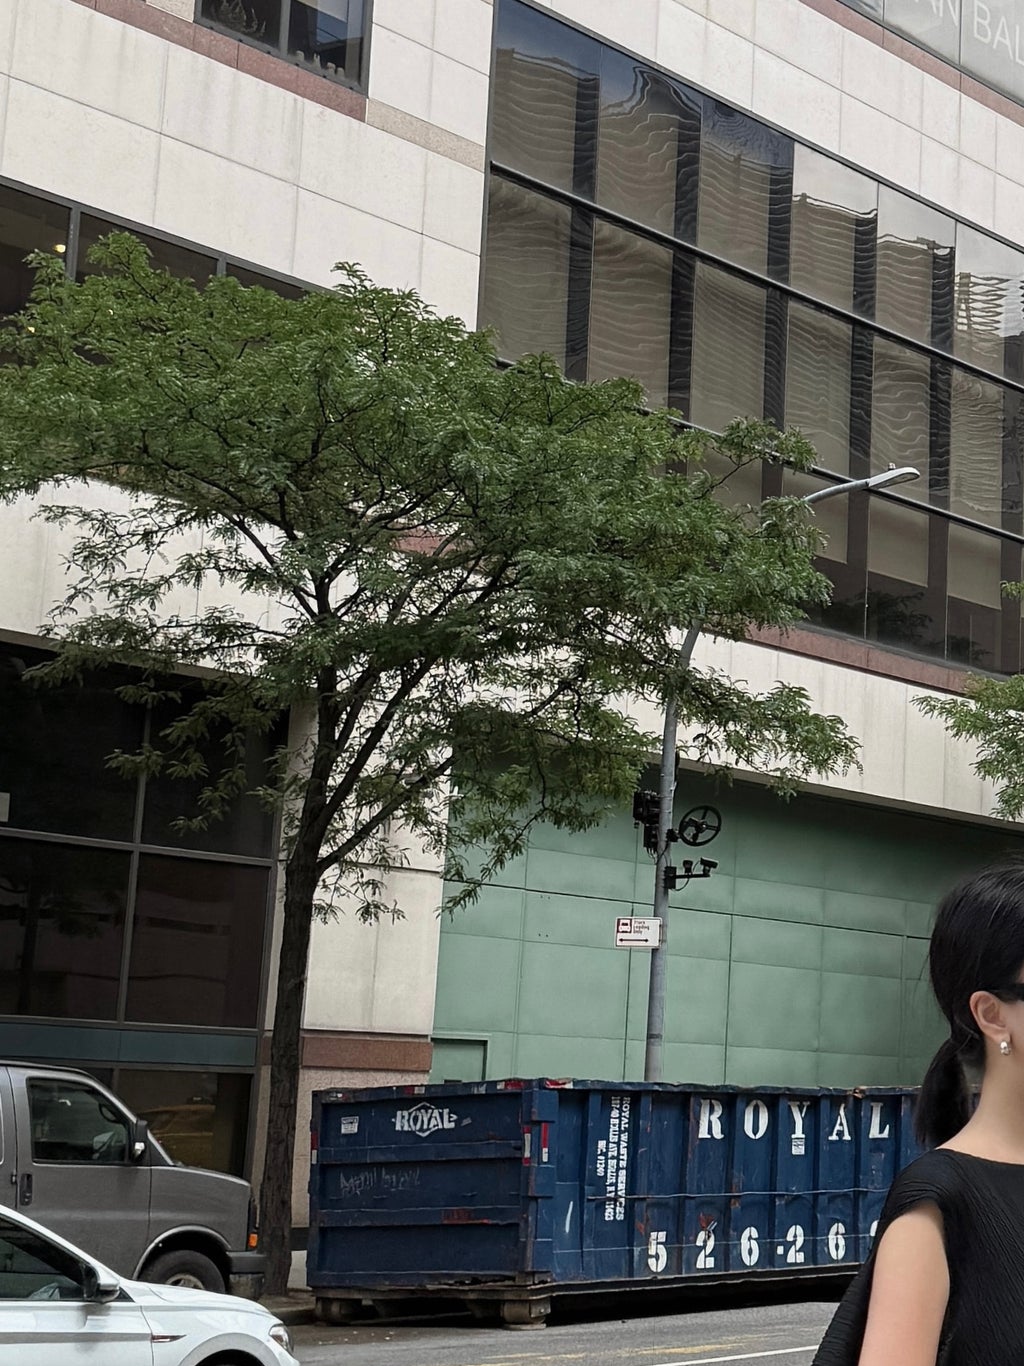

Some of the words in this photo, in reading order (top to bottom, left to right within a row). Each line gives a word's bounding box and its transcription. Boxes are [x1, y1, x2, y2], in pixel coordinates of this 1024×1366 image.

[395, 1108, 456, 1132] ROYAL
[621, 1096, 631, 1131] ROYAL
[698, 1099, 889, 1140] ROYAL
[619, 1132, 629, 1168] WASTE
[615, 1169, 627, 1221] SERVICES
